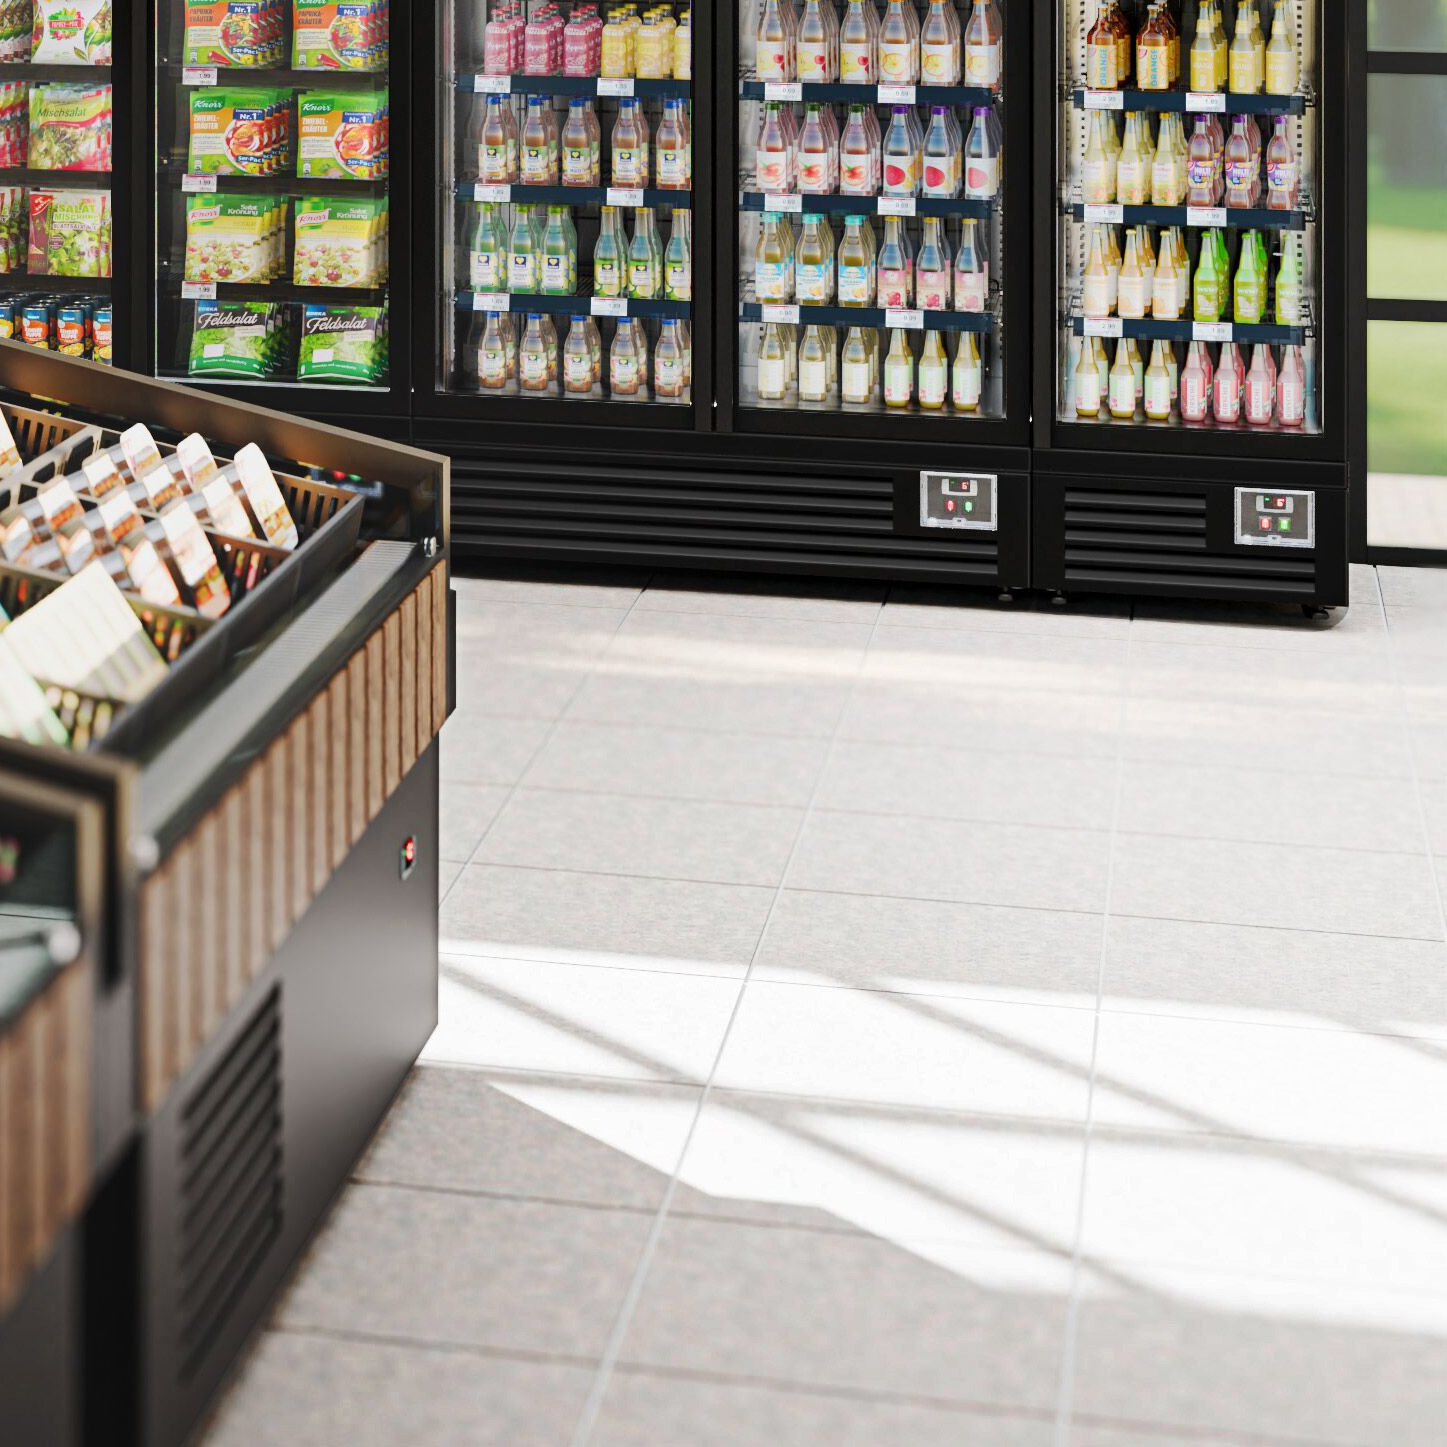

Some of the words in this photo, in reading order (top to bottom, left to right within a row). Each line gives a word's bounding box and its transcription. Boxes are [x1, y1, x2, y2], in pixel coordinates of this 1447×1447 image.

[194, 99, 223, 109] Knorr
[302, 102, 332, 112] Knorr
[37, 107, 86, 118] Mischsalat
[191, 208, 219, 220] Knorr
[299, 212, 326, 224] Knorr
[198, 311, 258, 329] Feldsalat
[306, 316, 368, 334] Feldsalat
